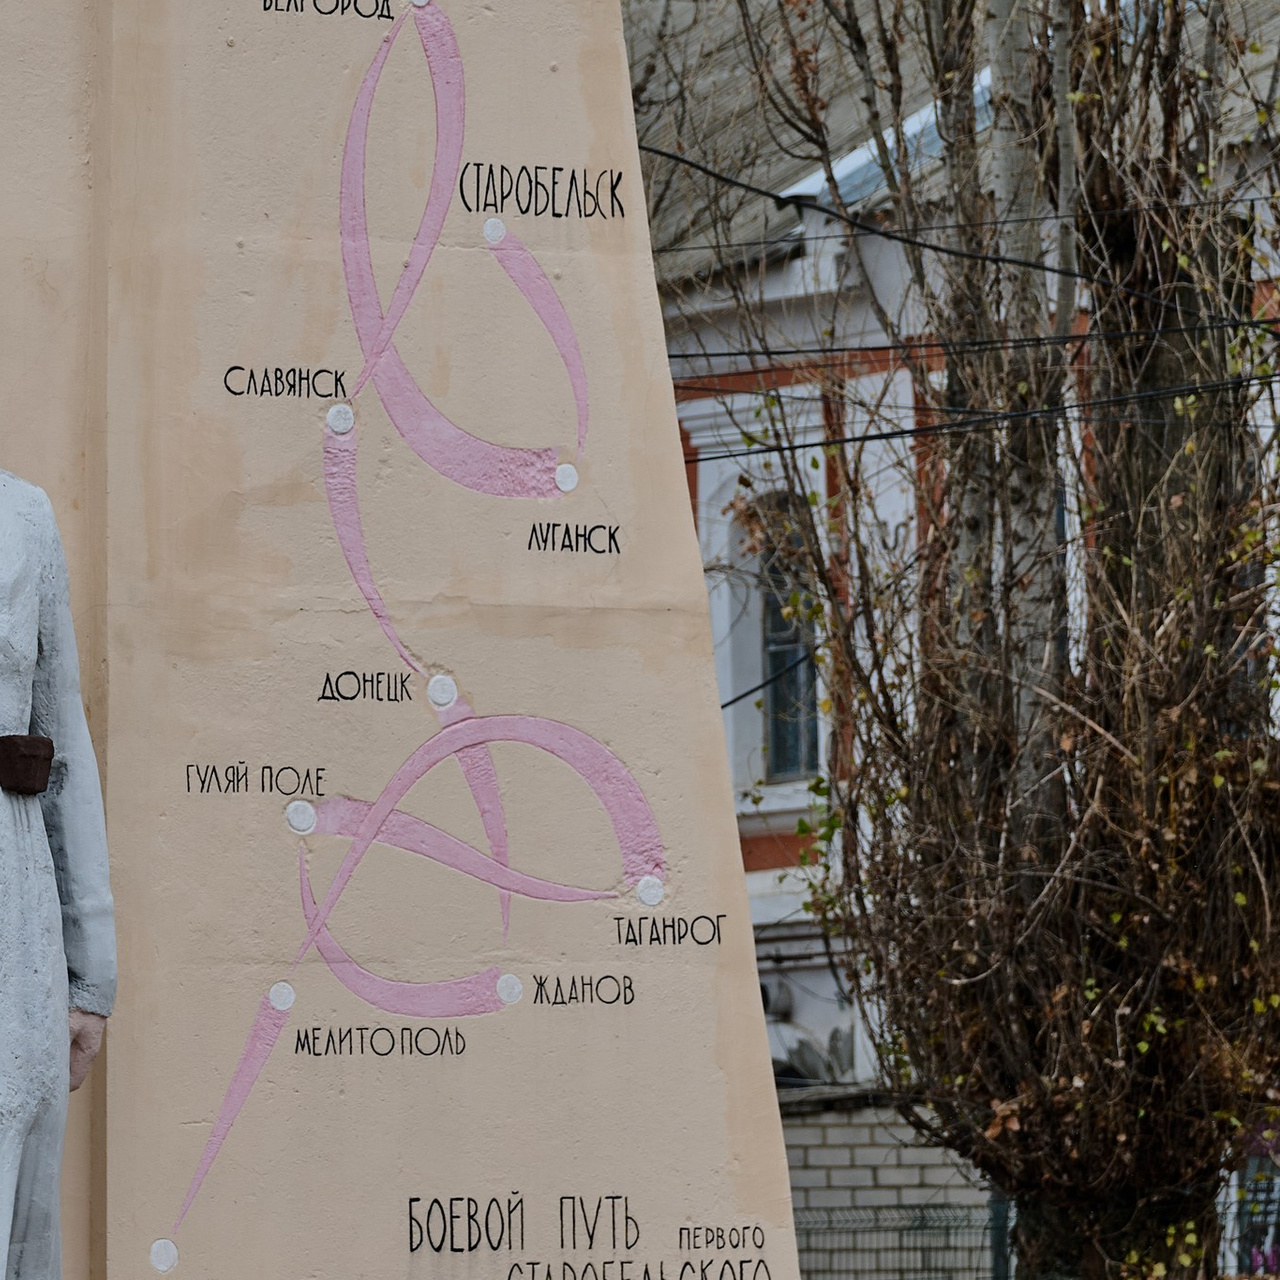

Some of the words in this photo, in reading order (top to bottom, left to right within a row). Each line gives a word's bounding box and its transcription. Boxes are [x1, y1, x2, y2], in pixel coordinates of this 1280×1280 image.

[459, 162, 625, 220] СТАРОБЕЛЬСК
[223, 365, 347, 399] СЛАВЯНСК
[527, 522, 621, 555] ЛУГАНСК
[316, 670, 413, 704] ДОНЕЦК
[186, 760, 249, 794] ГУЛЯЙ
[261, 765, 326, 797] ПОЛЕ
[613, 914, 727, 947] ТАГАНРОГ
[532, 974, 635, 1007] ЖДАНОВ
[294, 1026, 466, 1057] МЕЛИТОПОЛЬ
[408, 1190, 525, 1254] БОЕВОЙ
[559, 1195, 640, 1251] ПУТЬ
[678, 1225, 765, 1251] ПЕРВОГО
